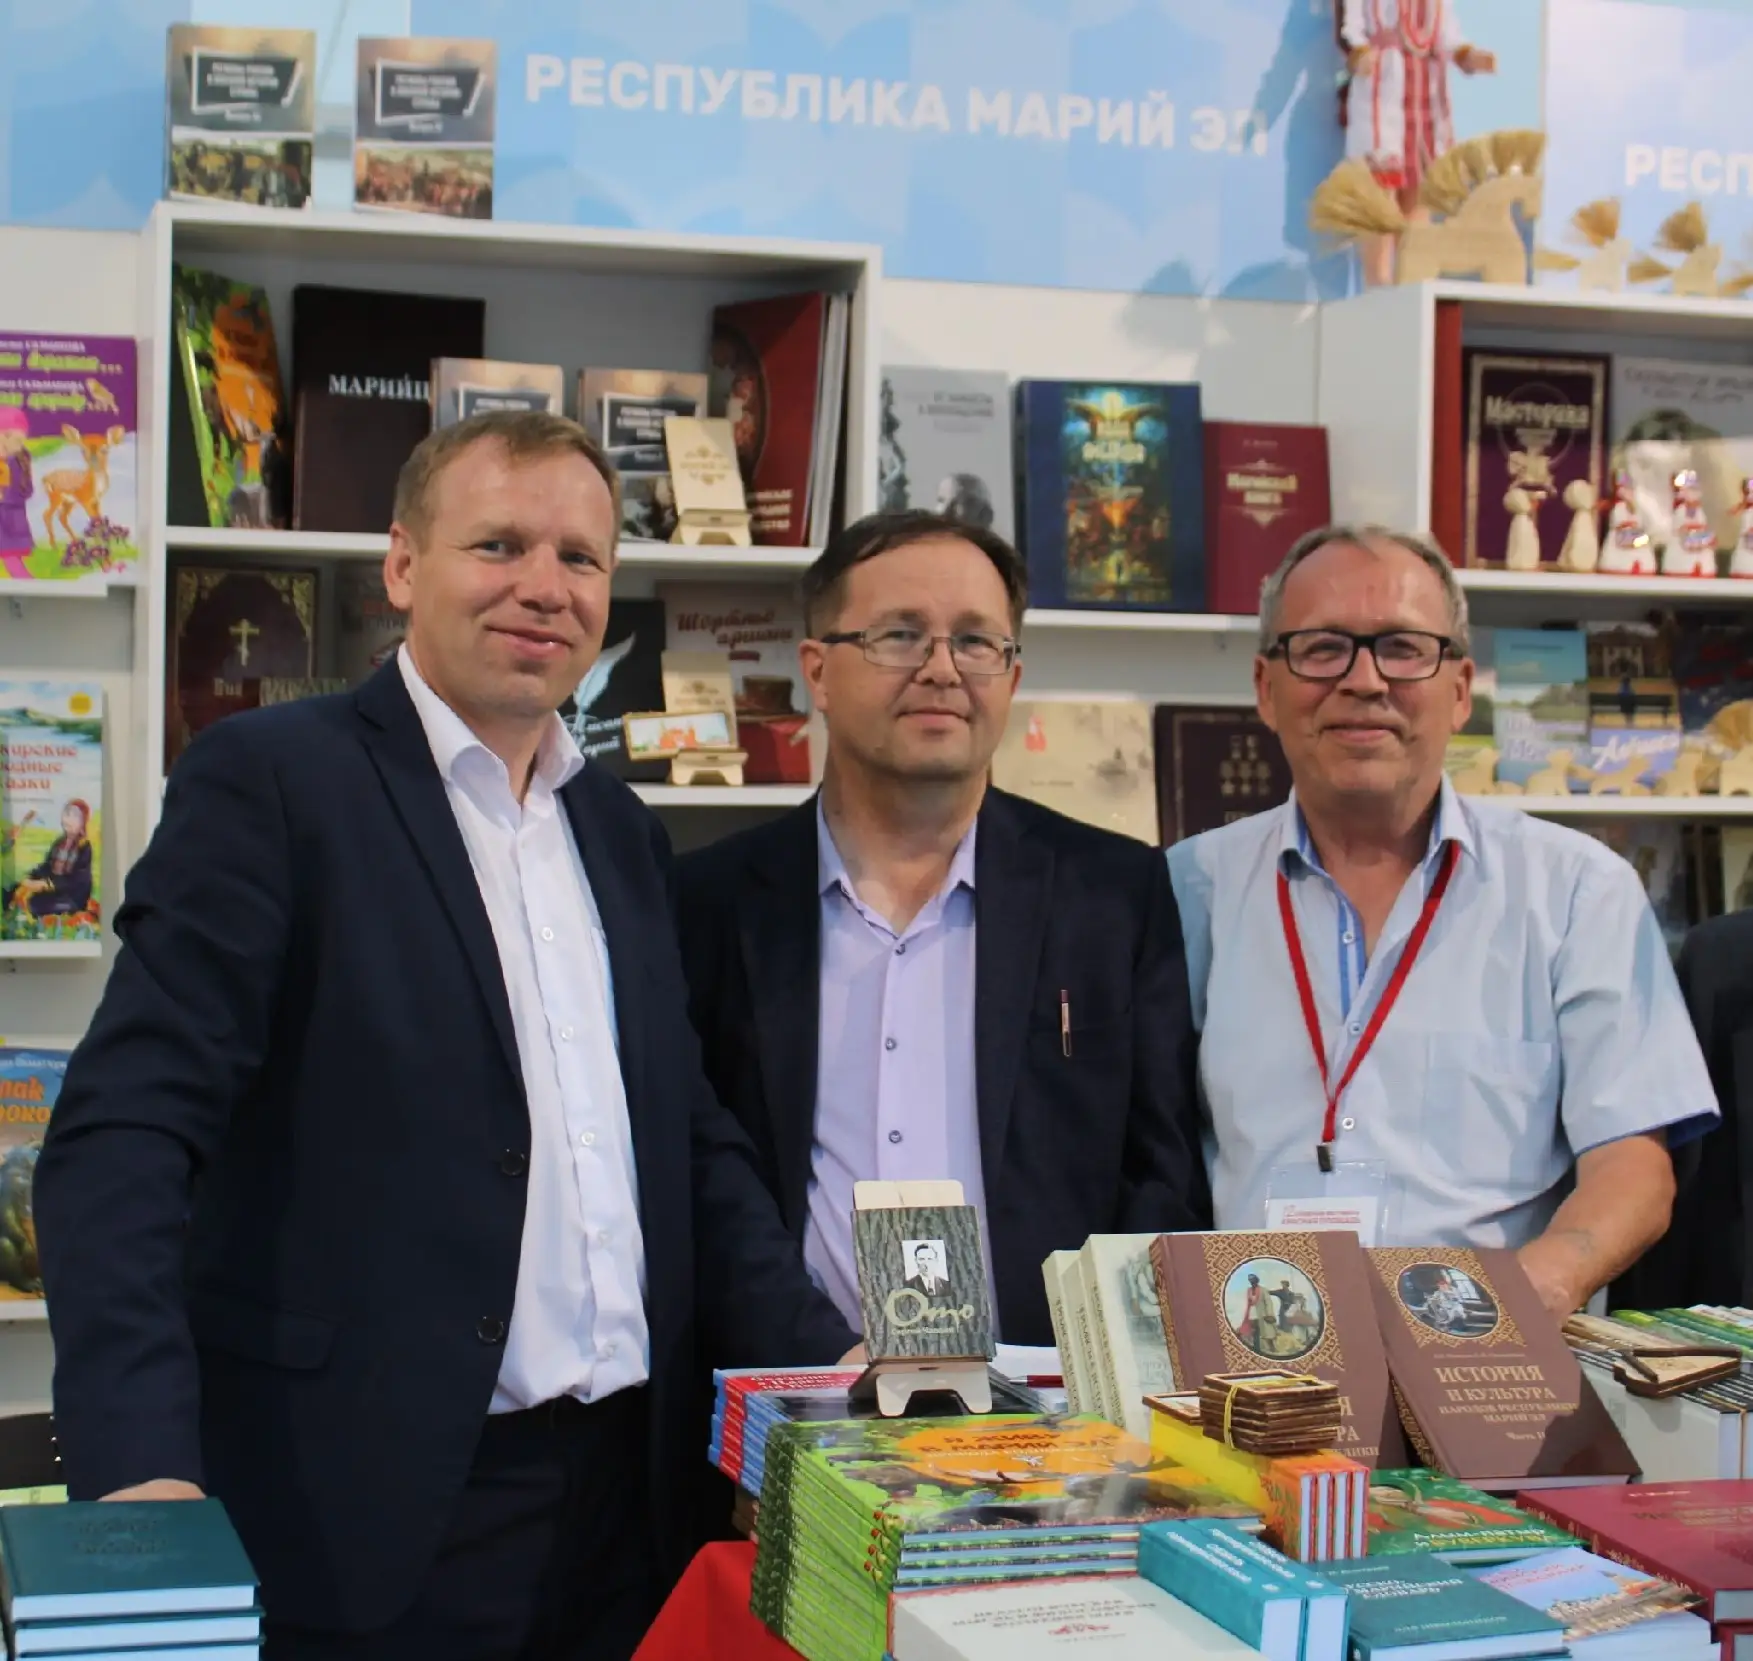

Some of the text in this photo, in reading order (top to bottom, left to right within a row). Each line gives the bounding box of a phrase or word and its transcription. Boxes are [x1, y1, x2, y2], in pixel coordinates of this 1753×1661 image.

[525, 54, 1269, 156] РЕСПУБЛИКА МАРИЙ ЭЛ
[1626, 144, 1753, 195] РЕСП
[1484, 396, 1591, 428] Масторава
[1434, 1365, 1545, 1383] ИСТОРИЯ
[1446, 1387, 1557, 1402] И КУЛЬТУРА
[1438, 1405, 1498, 1415] НАРОДОВ
